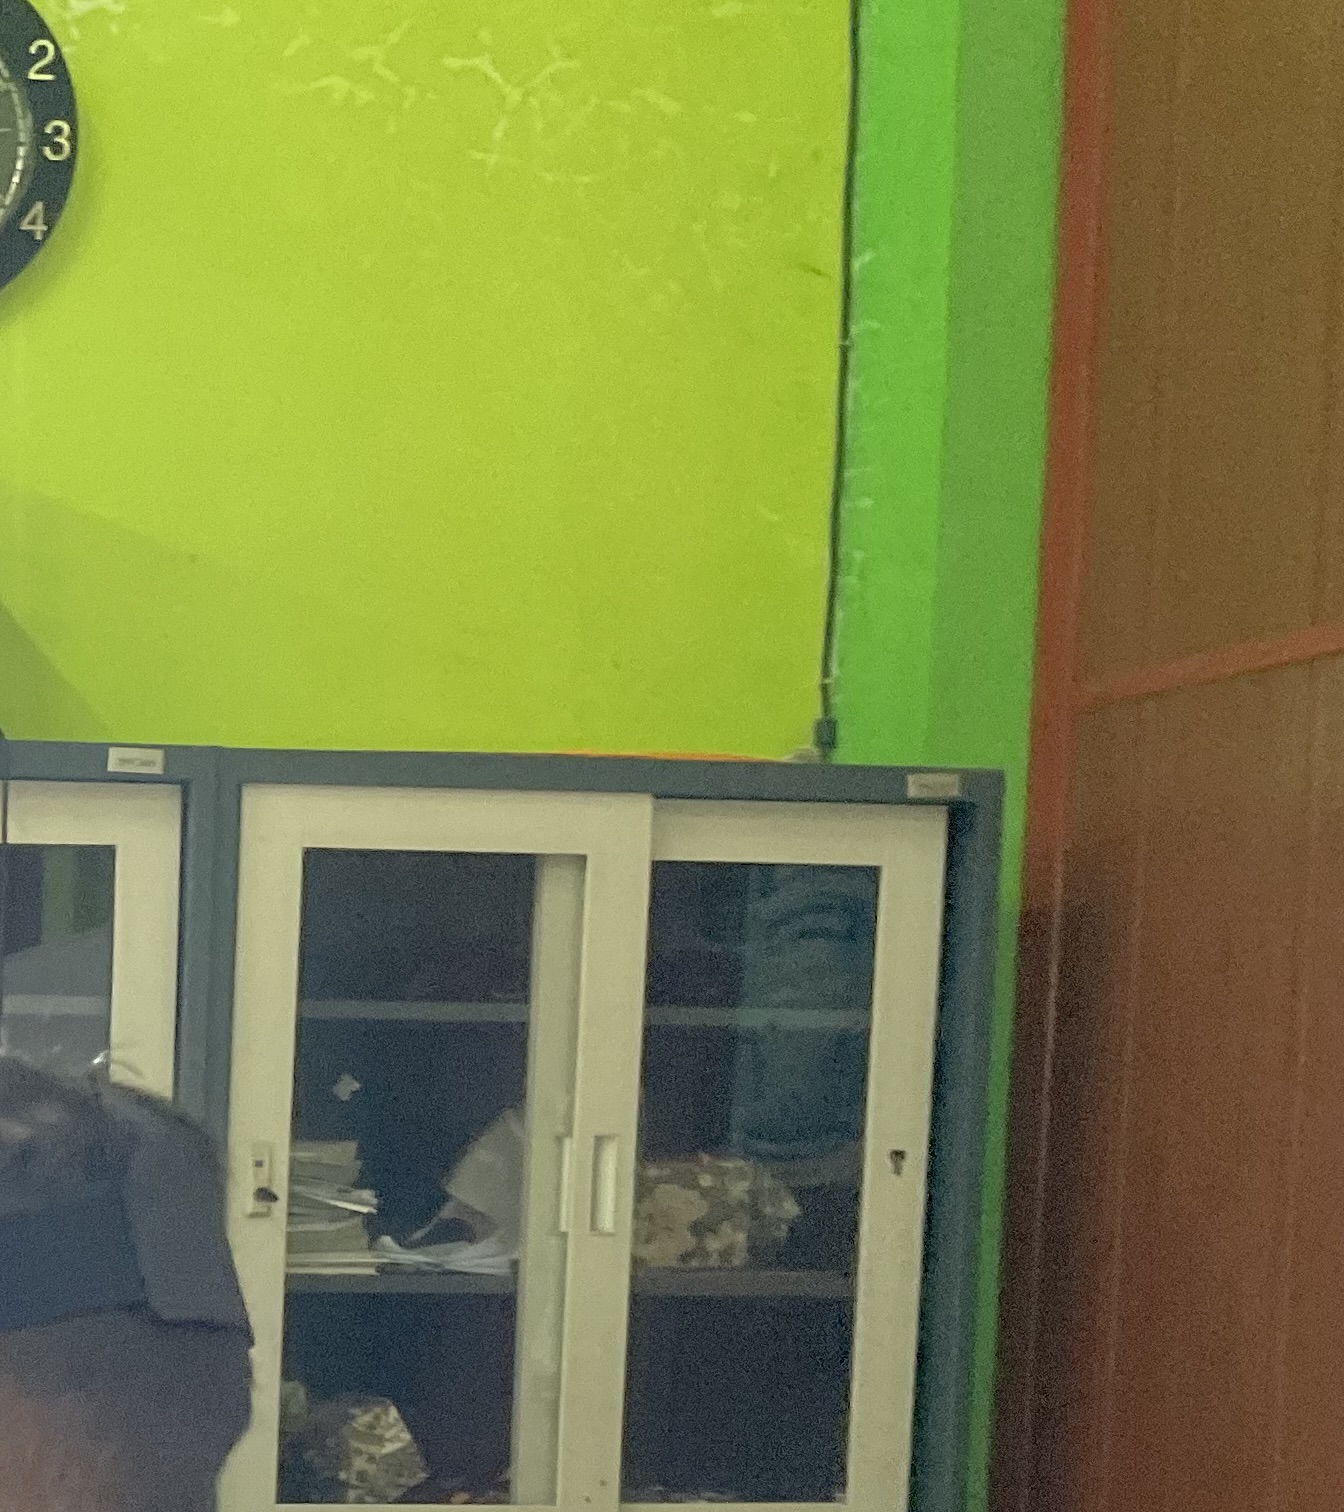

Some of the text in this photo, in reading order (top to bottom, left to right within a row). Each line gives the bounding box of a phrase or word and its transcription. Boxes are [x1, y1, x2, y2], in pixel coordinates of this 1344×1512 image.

[26, 40, 57, 81] 2
[42, 120, 72, 161] 3
[19, 201, 49, 241] 4
